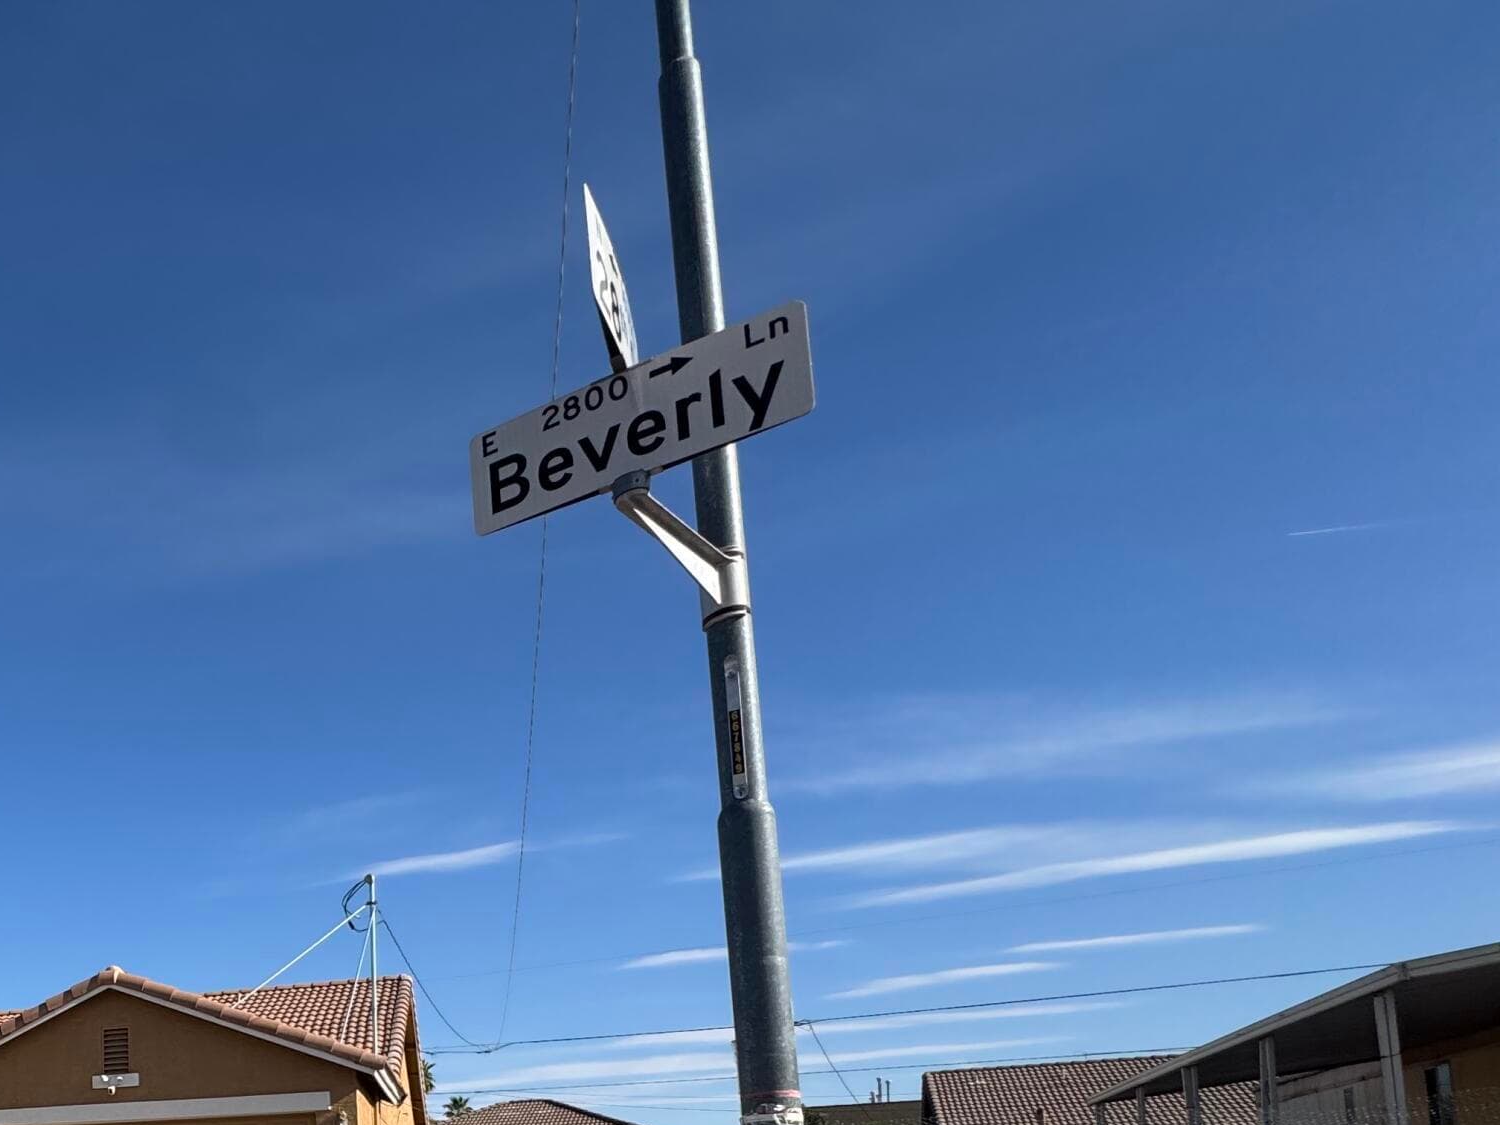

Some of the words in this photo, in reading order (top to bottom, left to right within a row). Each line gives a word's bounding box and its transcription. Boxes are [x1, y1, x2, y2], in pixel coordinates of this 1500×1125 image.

[481, 431, 498, 458] E
[542, 375, 628, 432] 2800
[743, 312, 790, 349] Ln
[488, 359, 785, 514] Beverly
